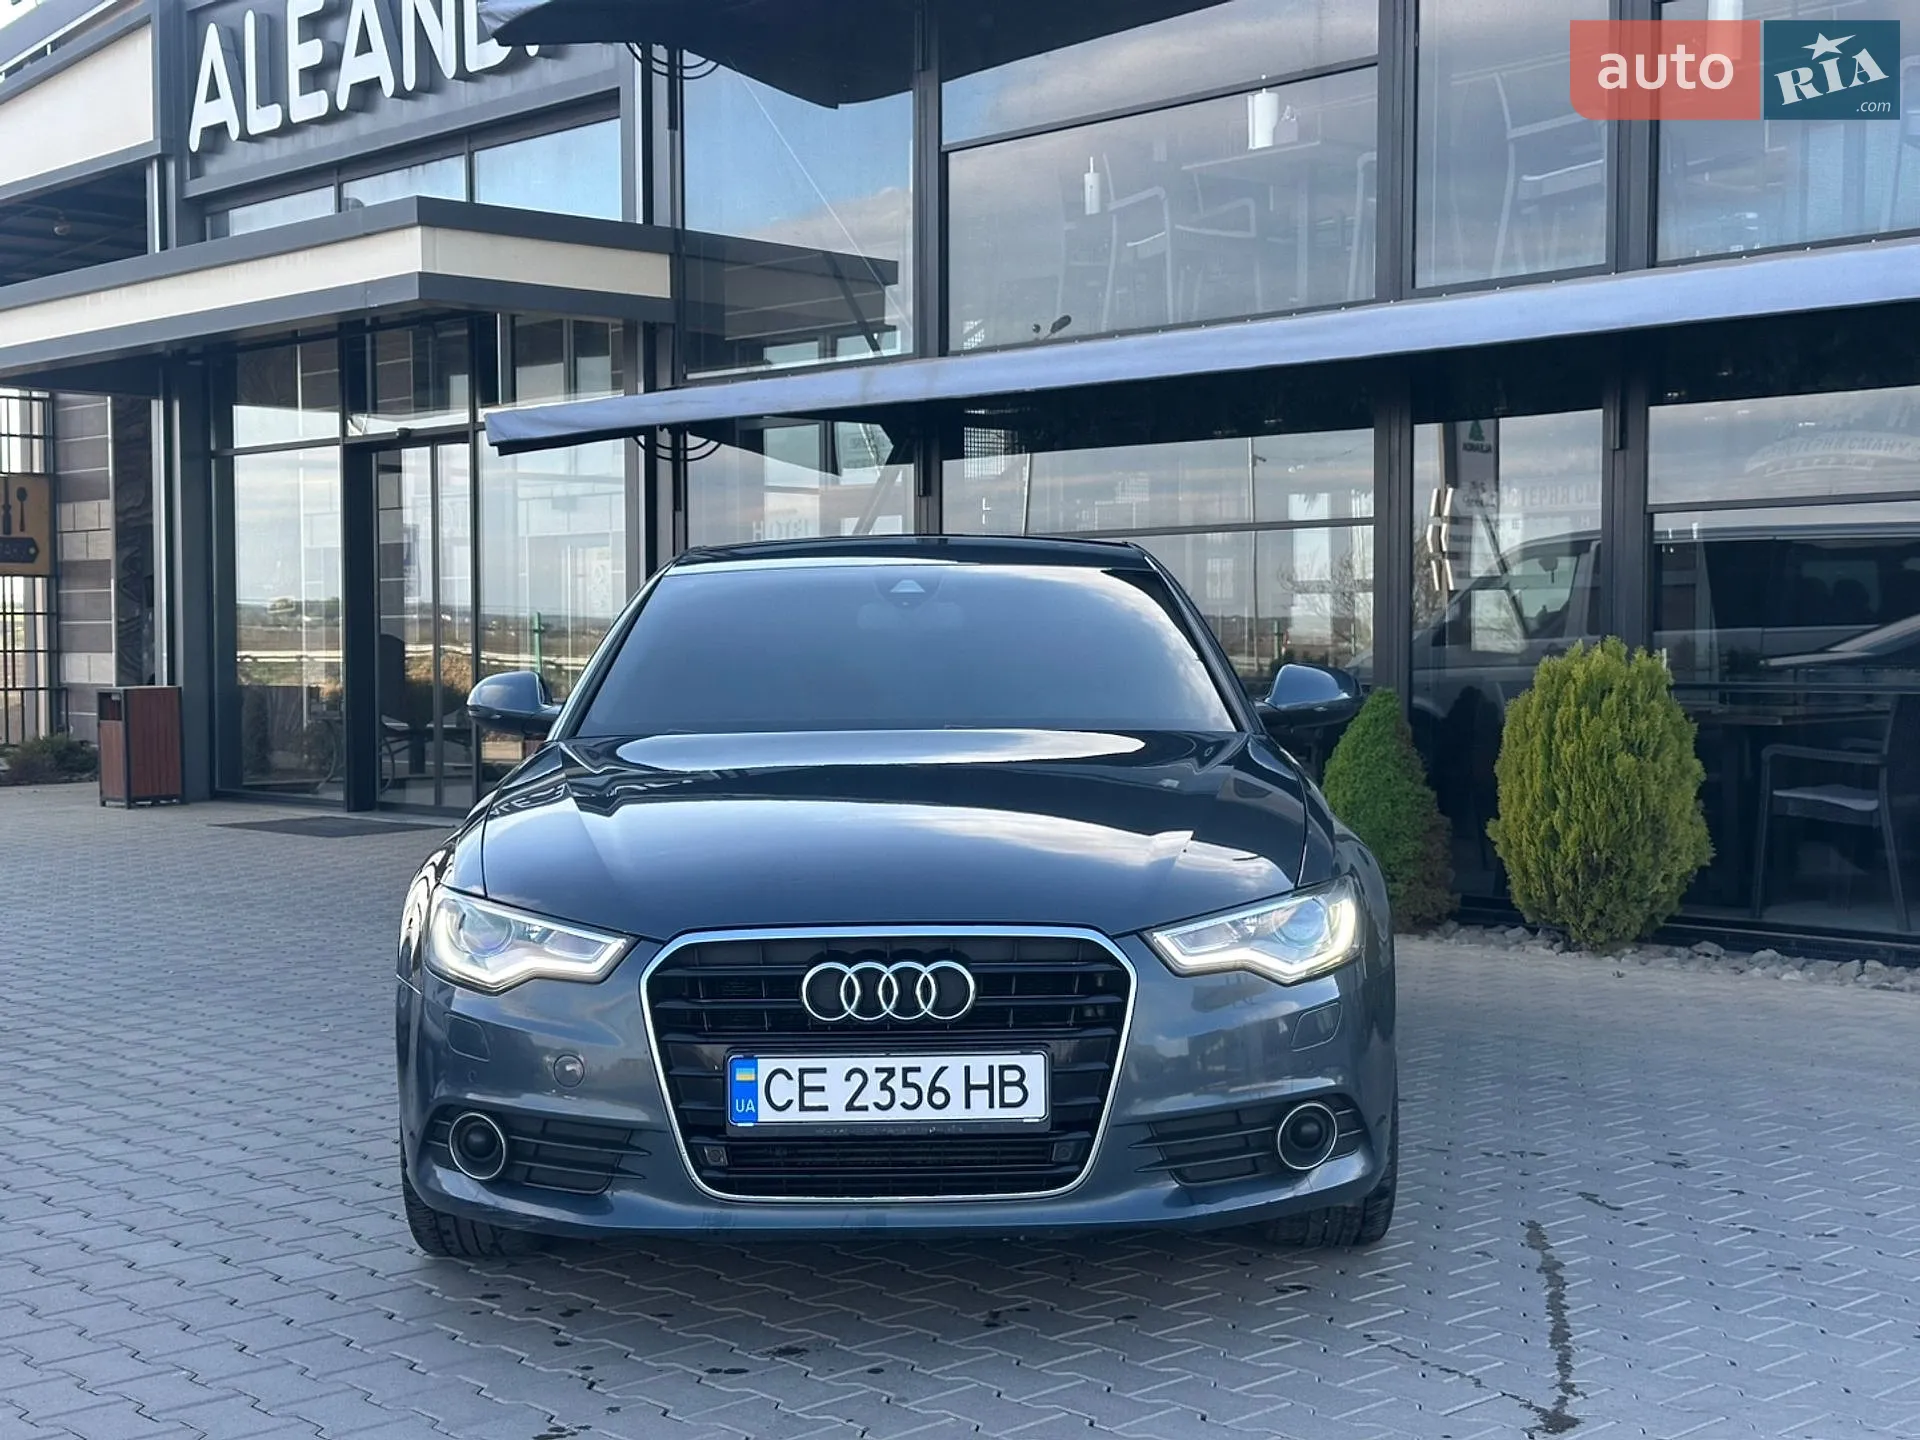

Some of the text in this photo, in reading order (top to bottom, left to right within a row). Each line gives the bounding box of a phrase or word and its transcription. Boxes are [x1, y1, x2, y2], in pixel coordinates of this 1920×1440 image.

[189, 0, 539, 153] ALEAND
[735, 1099, 756, 1113] UA
[764, 1063, 1029, 1112] CE 2356 HB
